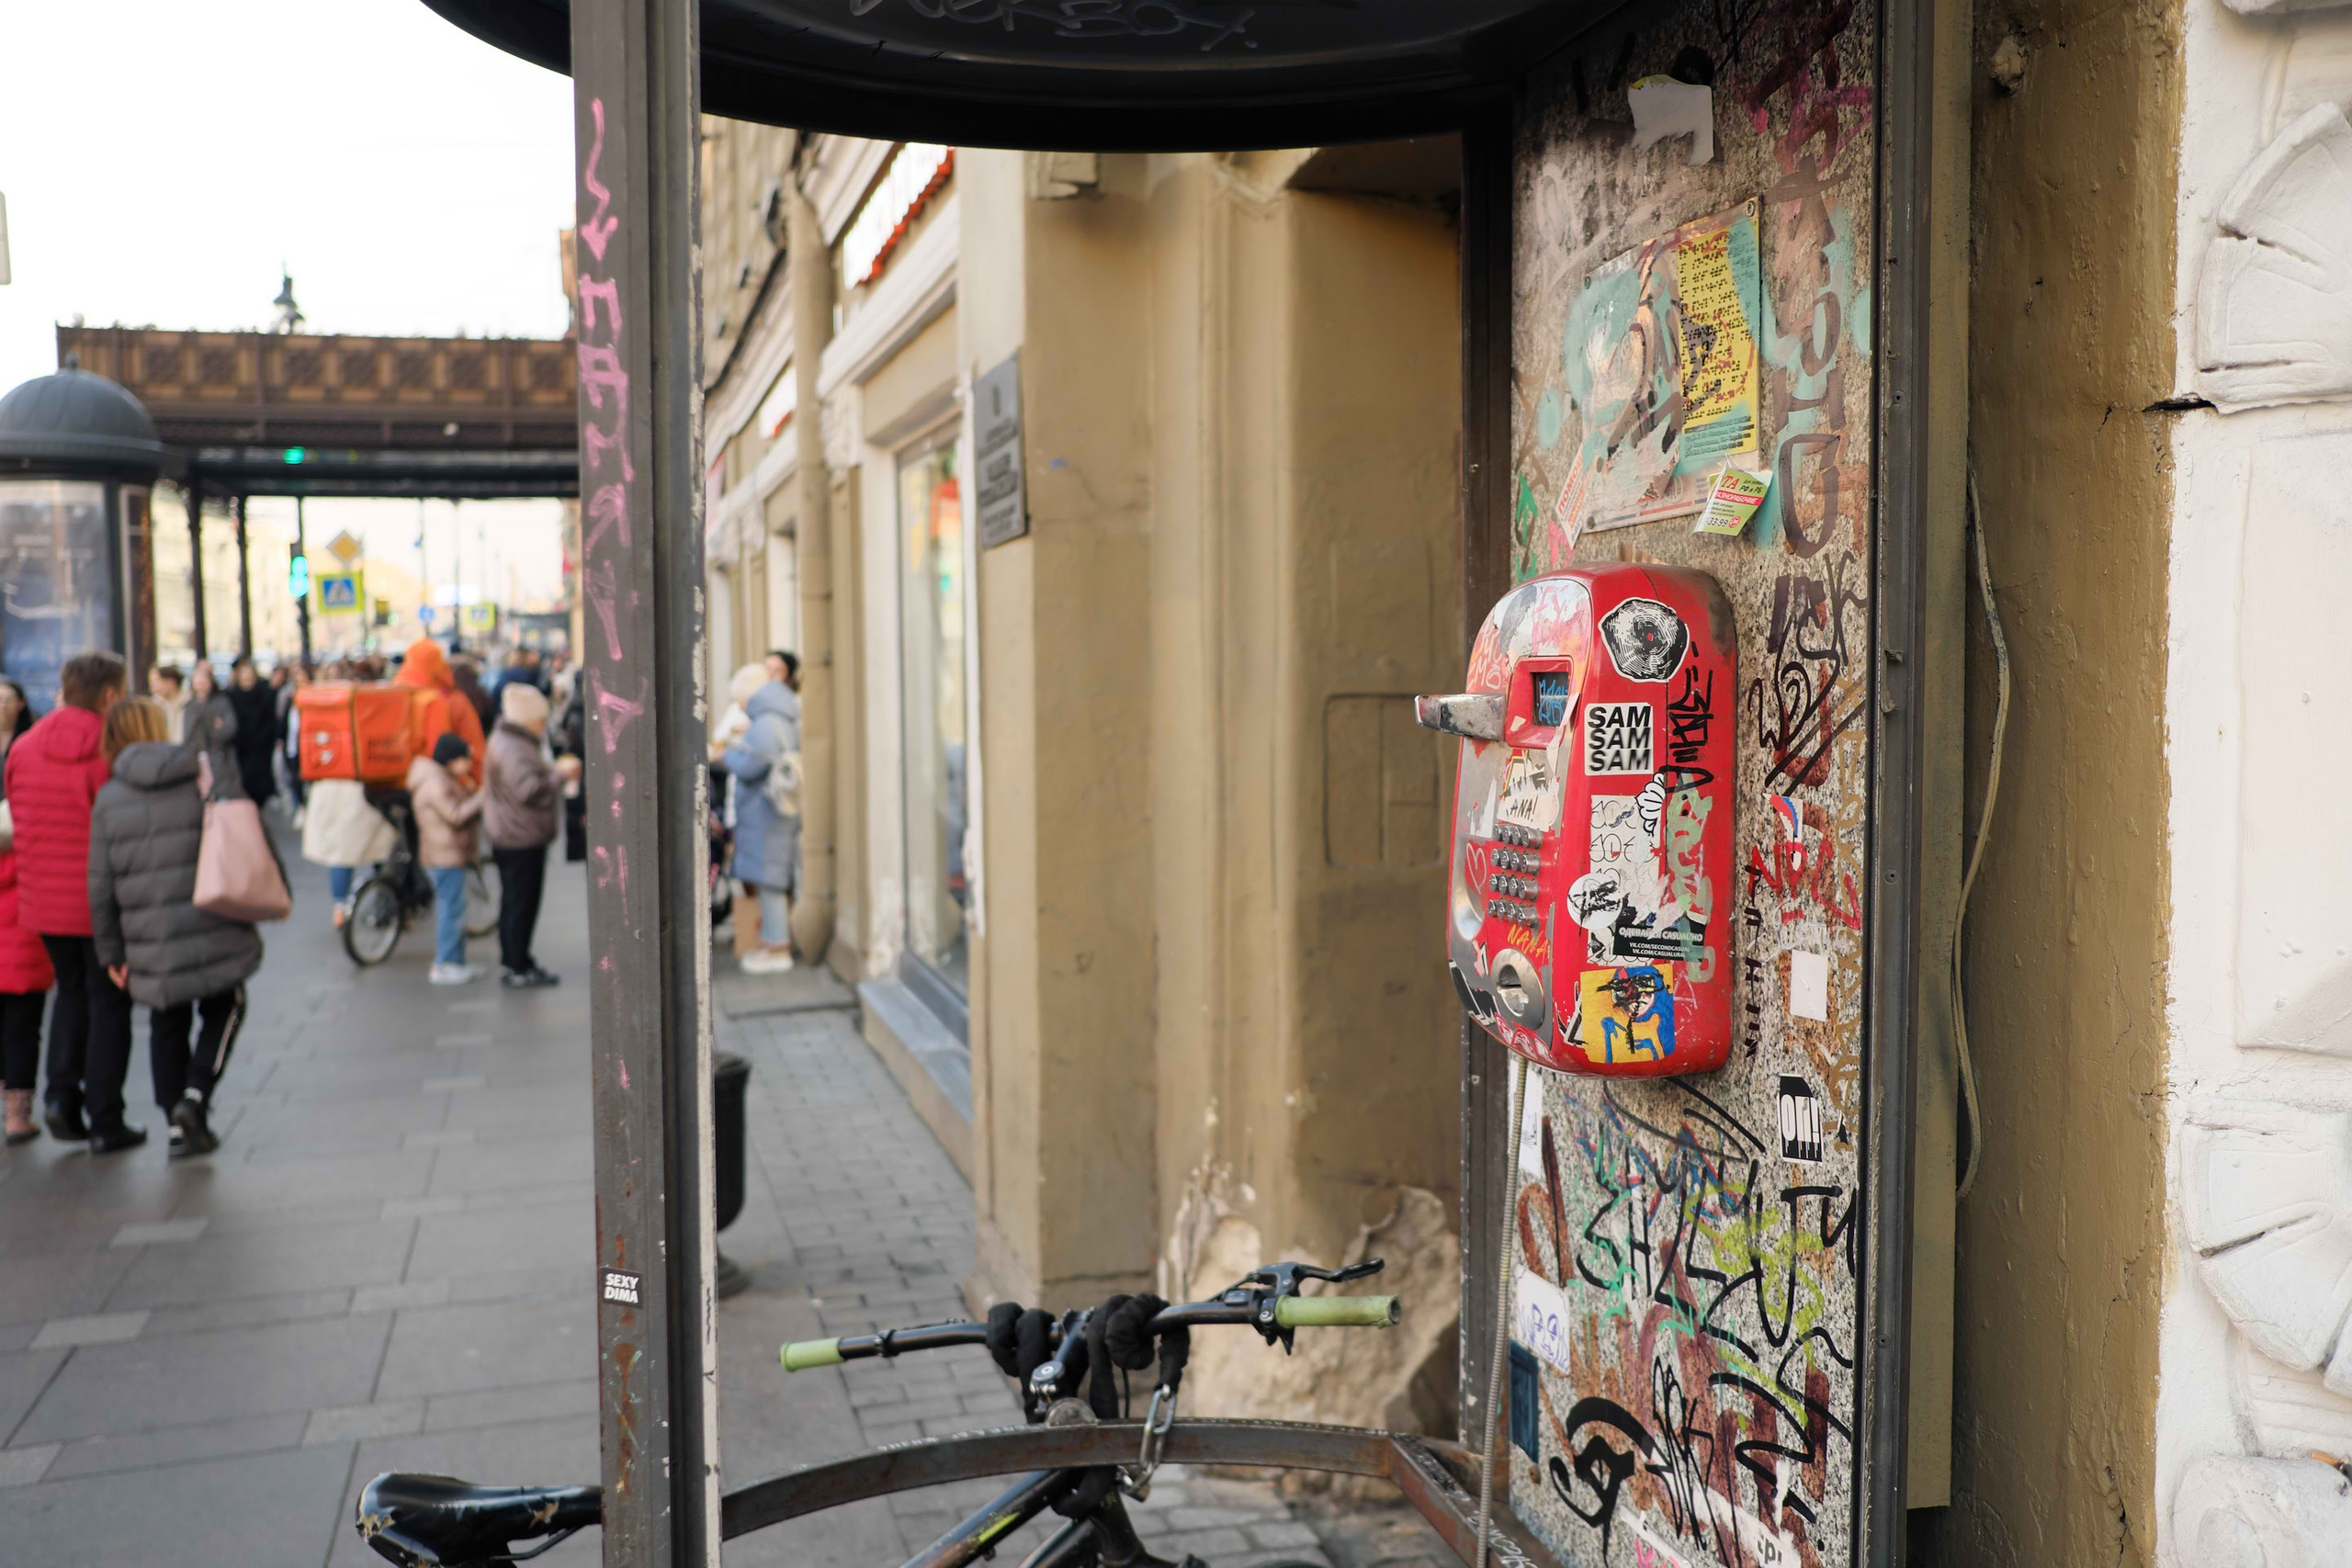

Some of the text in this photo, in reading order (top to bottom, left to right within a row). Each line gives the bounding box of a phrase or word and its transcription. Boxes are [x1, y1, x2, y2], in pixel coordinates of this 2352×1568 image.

[1715, 491, 1758, 504] АЗНОРАБОЧИЕ
[1588, 706, 1651, 728] SAM
[1589, 728, 1651, 750] SAM
[1589, 750, 1651, 771] SAM
[1507, 795, 1539, 822] ANA!
[605, 1272, 639, 1290] SEXY
[604, 1286, 639, 1303] DIMA
